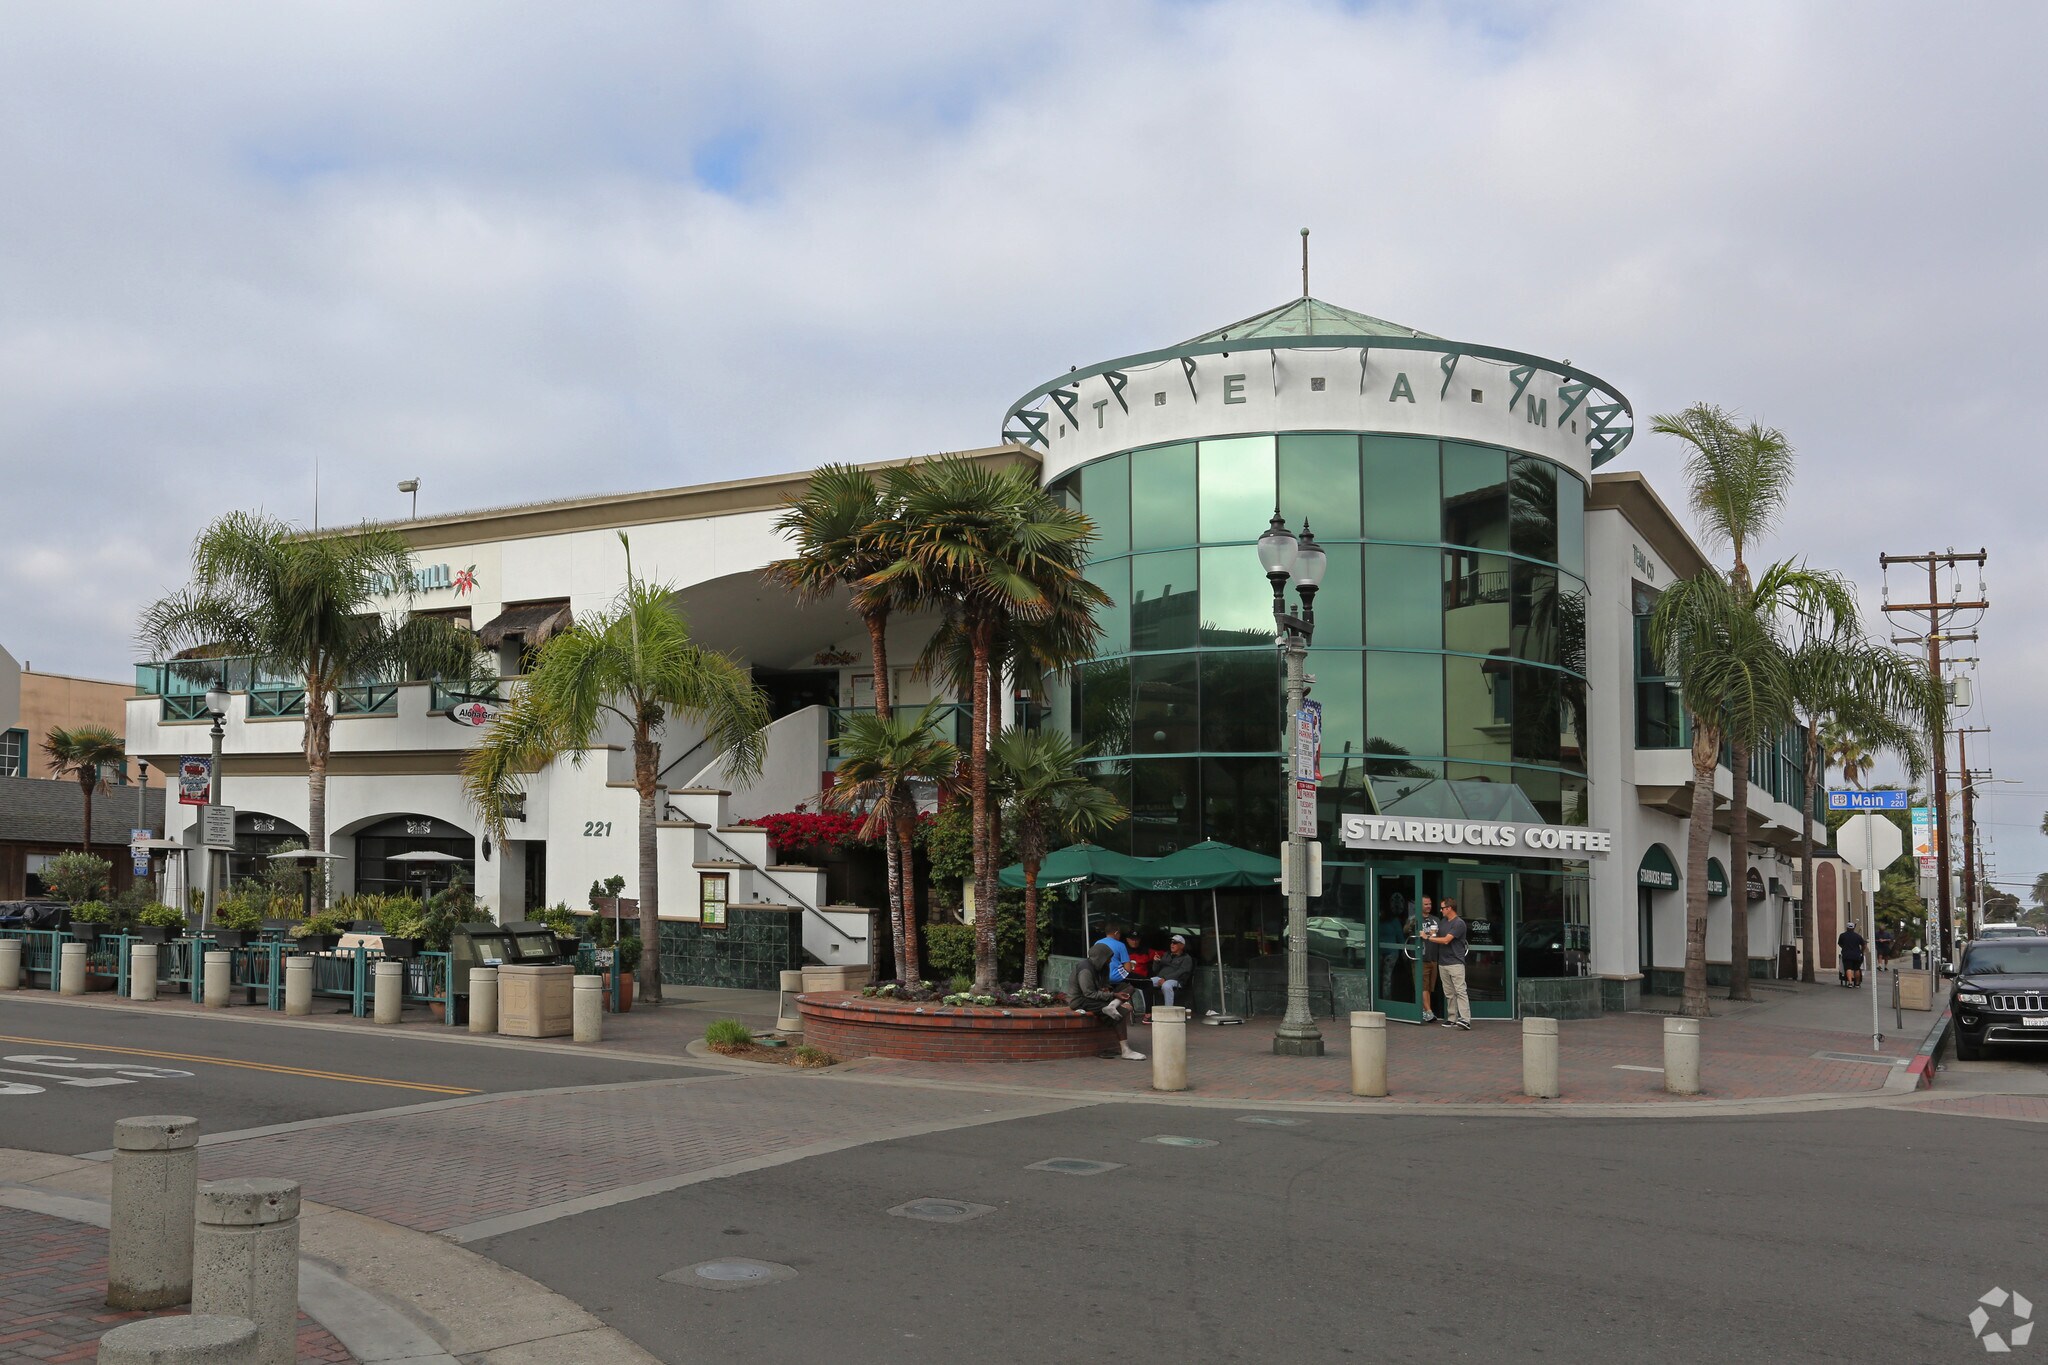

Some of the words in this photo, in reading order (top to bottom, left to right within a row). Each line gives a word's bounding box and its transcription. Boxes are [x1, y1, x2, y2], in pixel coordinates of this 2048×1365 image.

[1852, 794, 1883, 806] Main
[583, 821, 612, 837] 221
[1346, 819, 1516, 847] STARBUCKS
[1524, 827, 1611, 852] COFFEE
[1640, 868, 1660, 884] STARBUCKS
[1661, 871, 1673, 886] COFFEE
